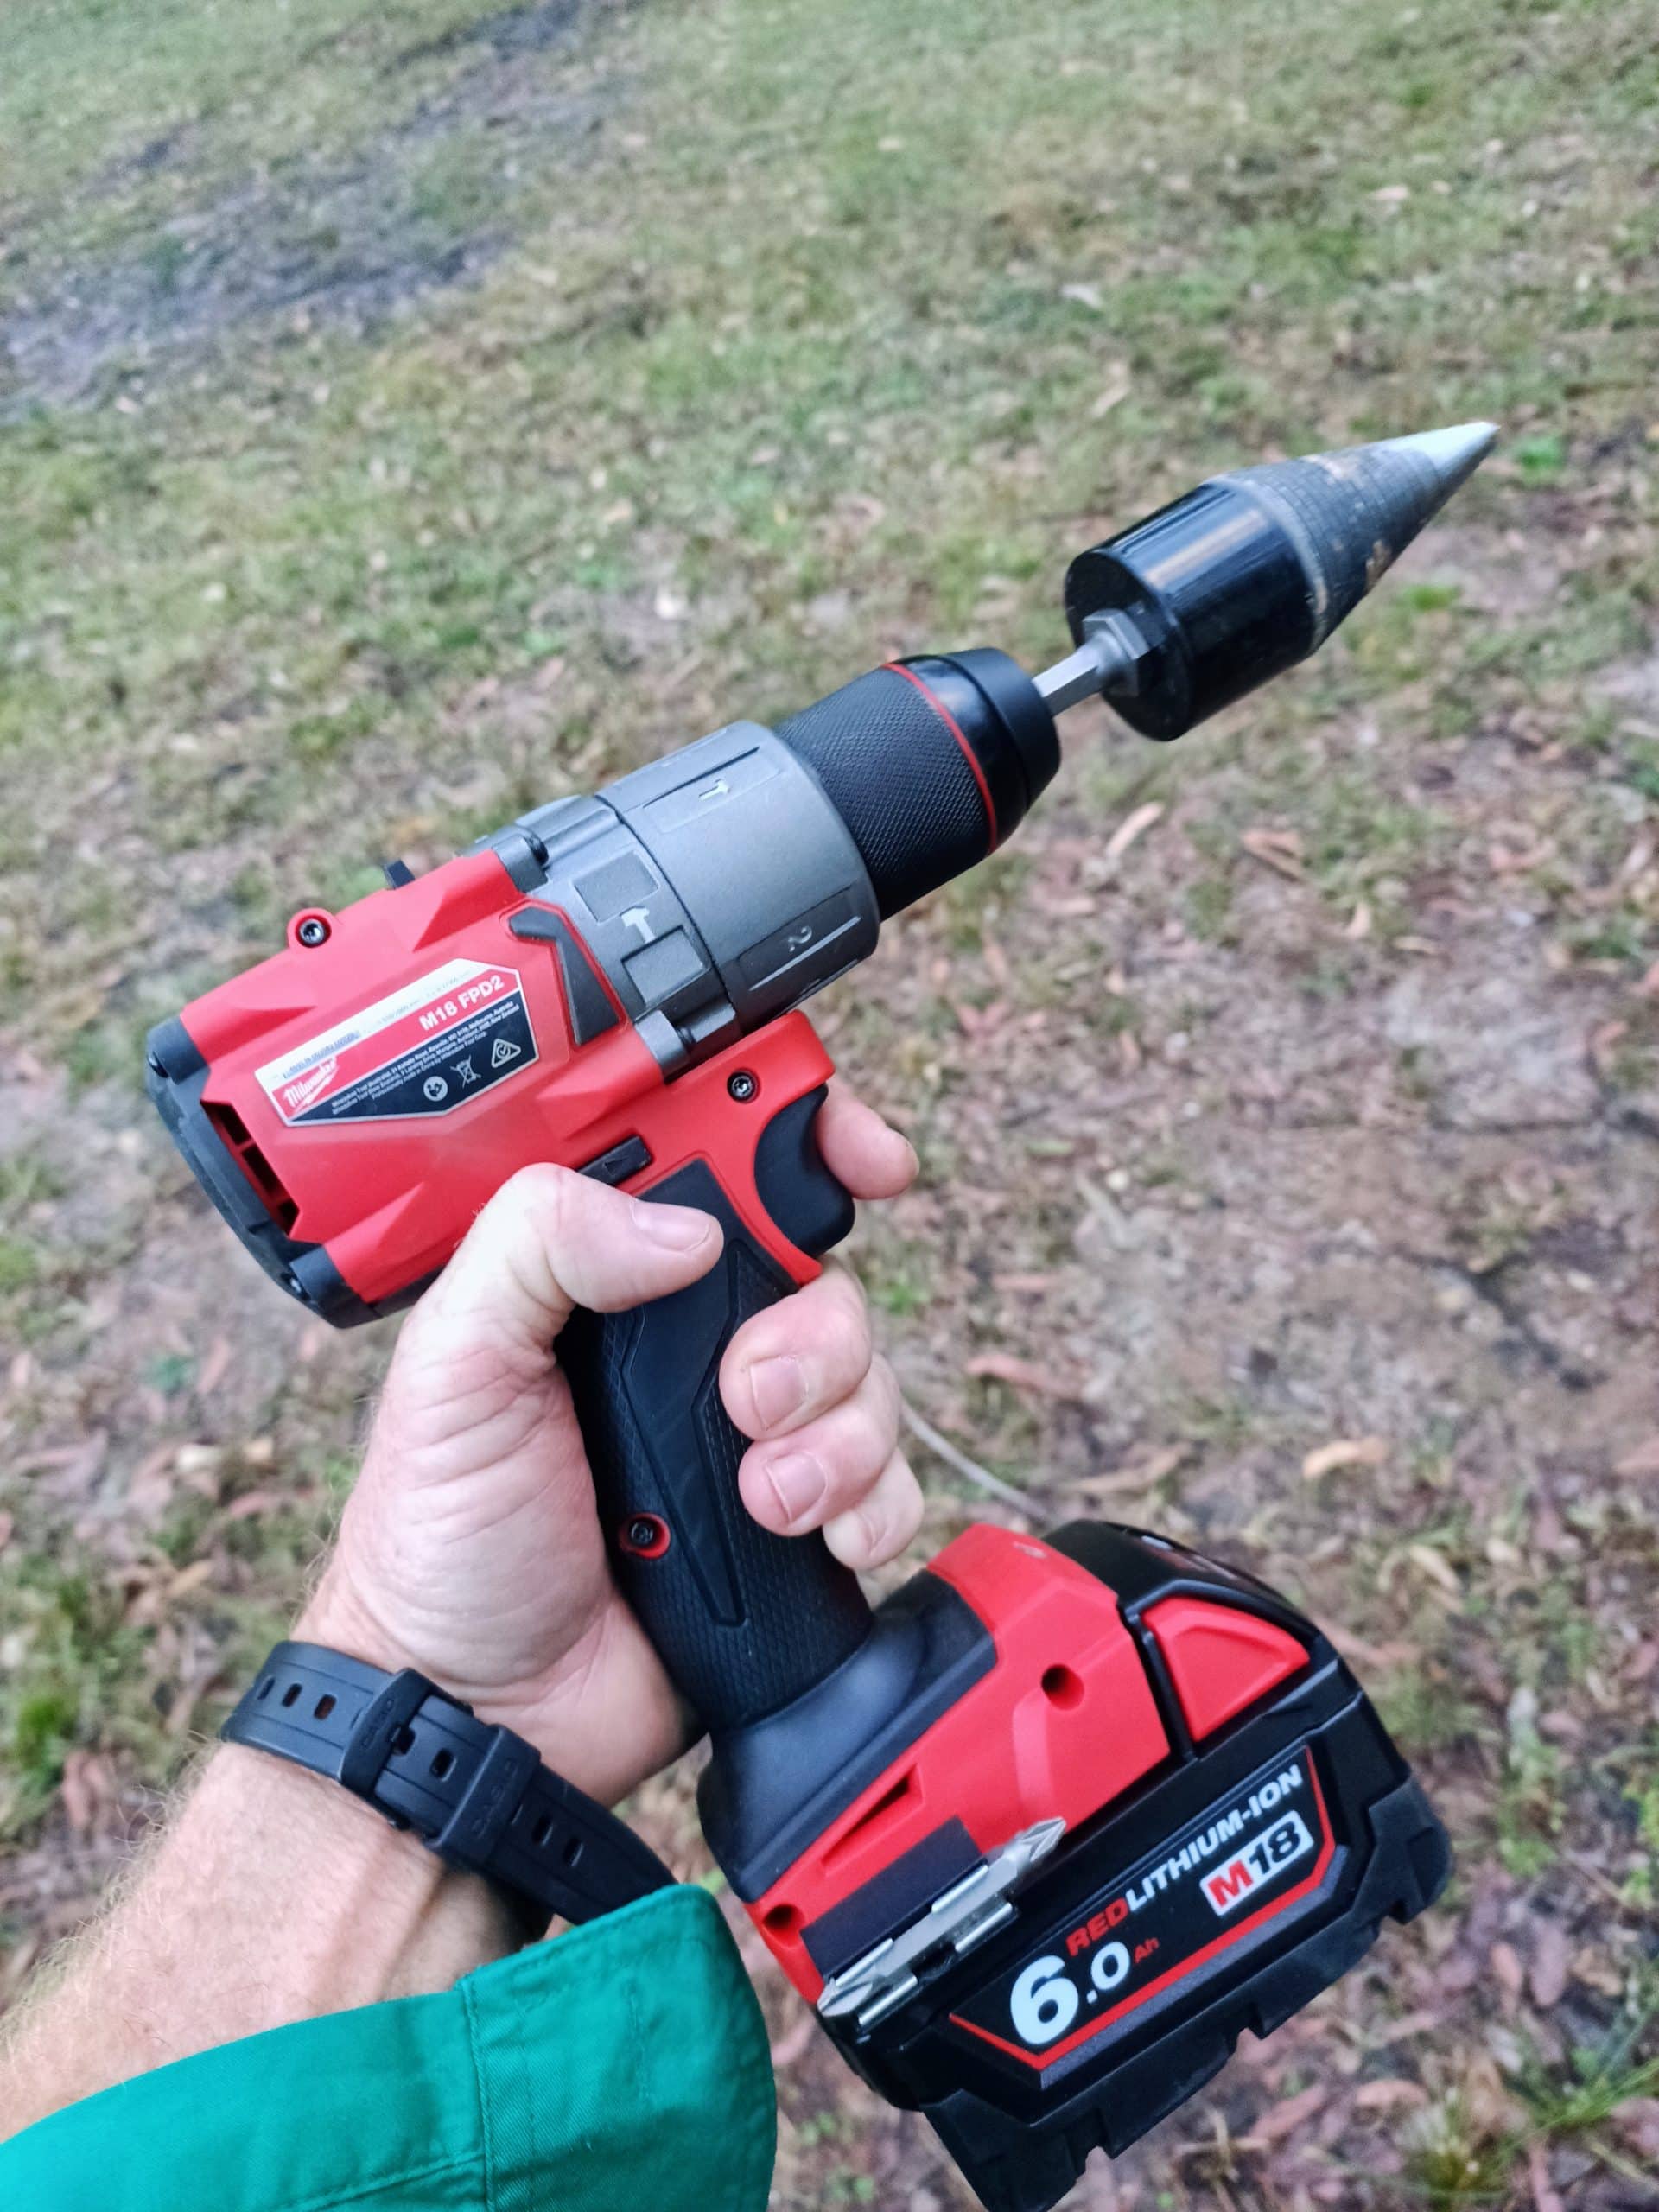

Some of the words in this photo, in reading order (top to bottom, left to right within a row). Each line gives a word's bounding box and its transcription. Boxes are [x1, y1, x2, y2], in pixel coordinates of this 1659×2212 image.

[418, 1001, 458, 1031] M18
[457, 975, 505, 1010] FPD2
[1207, 1820, 1302, 1909] M18
[1010, 1941, 1131, 2045] 6.0
[1134, 1937, 1160, 1963] Ah
